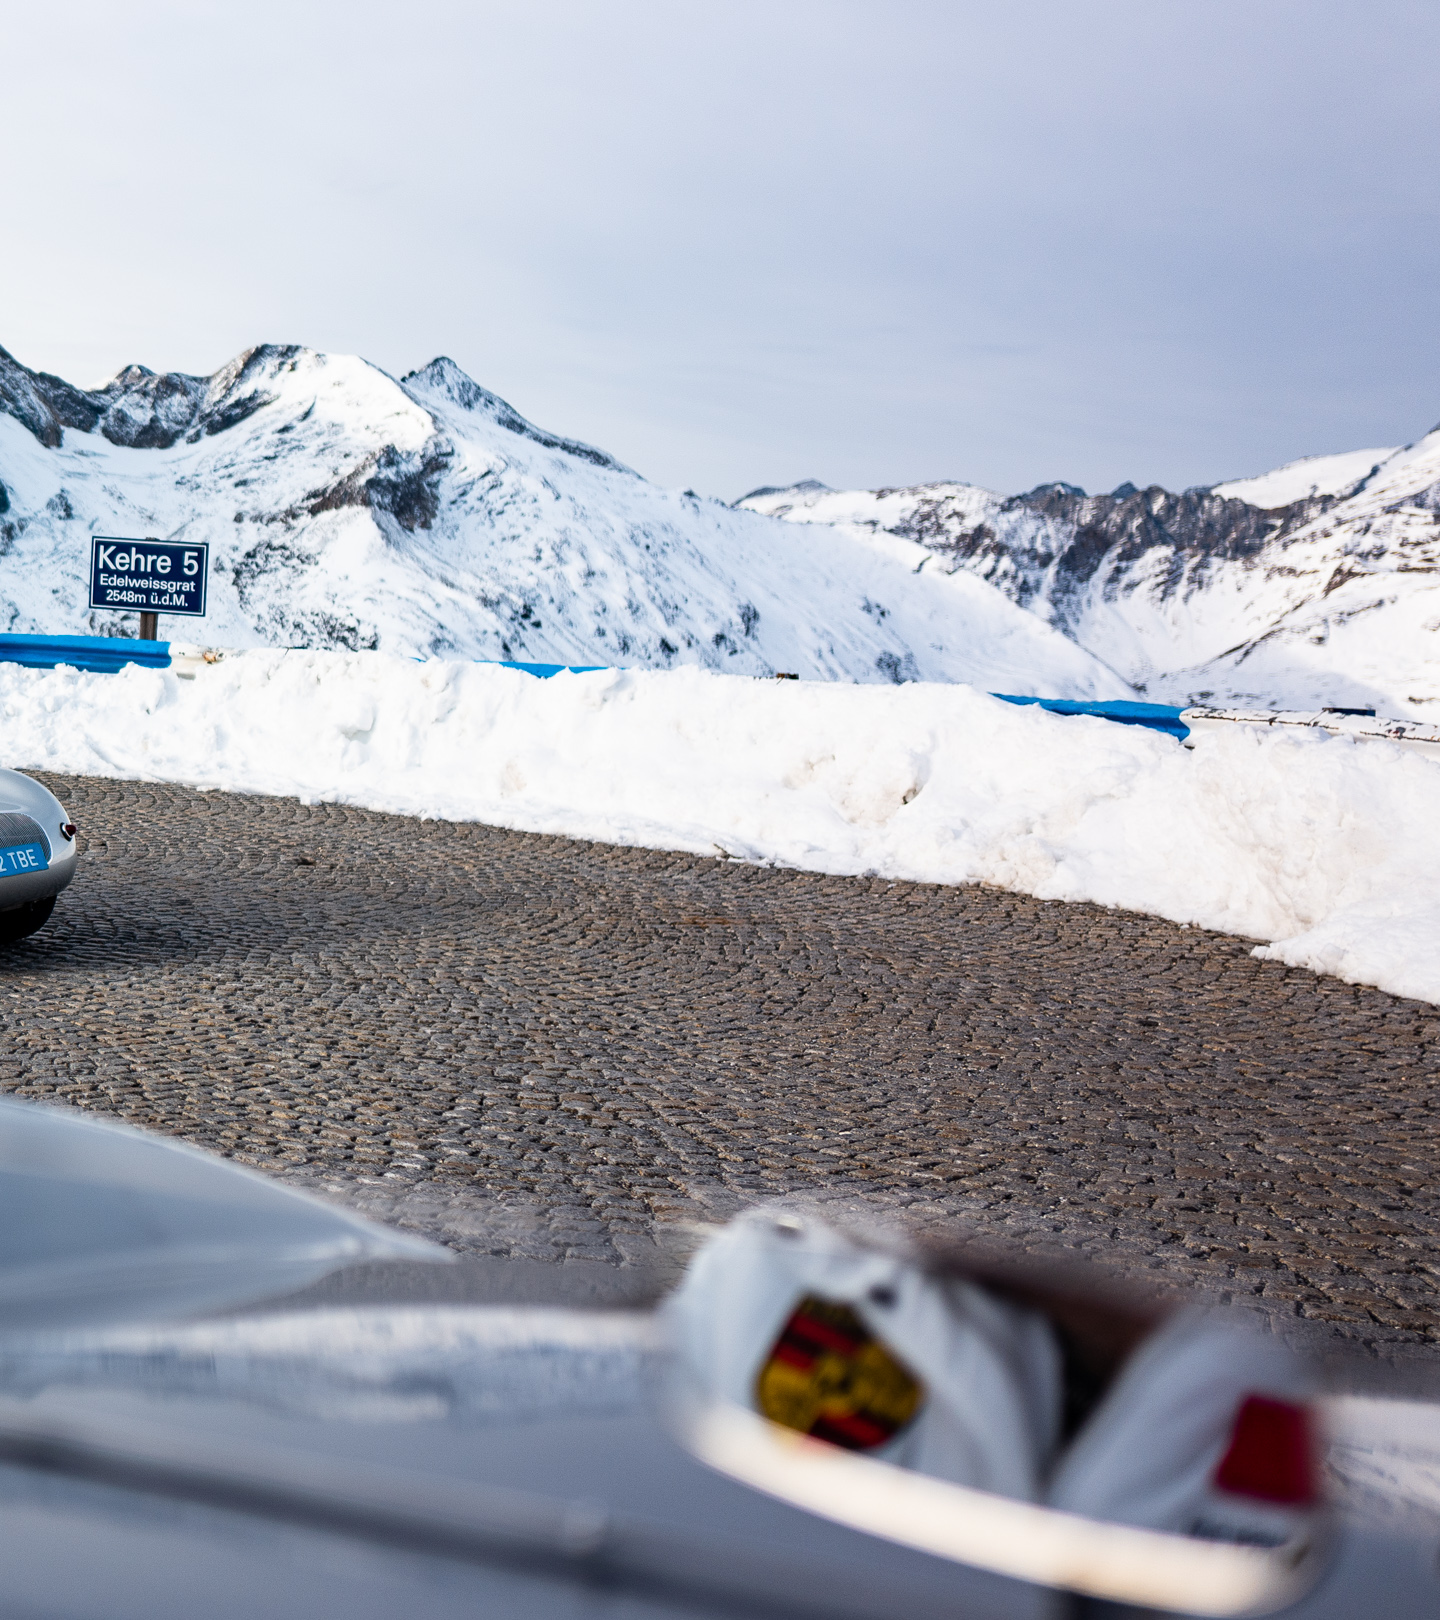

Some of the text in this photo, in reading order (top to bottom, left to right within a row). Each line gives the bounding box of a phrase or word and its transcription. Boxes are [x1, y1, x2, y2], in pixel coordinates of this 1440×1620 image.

[98, 545, 199, 575] Kehre 5
[100, 573, 196, 593] Edelweissgrat
[106, 590, 188, 607] 2548m ü.d.M.
[7, 849, 39, 869] TBE
